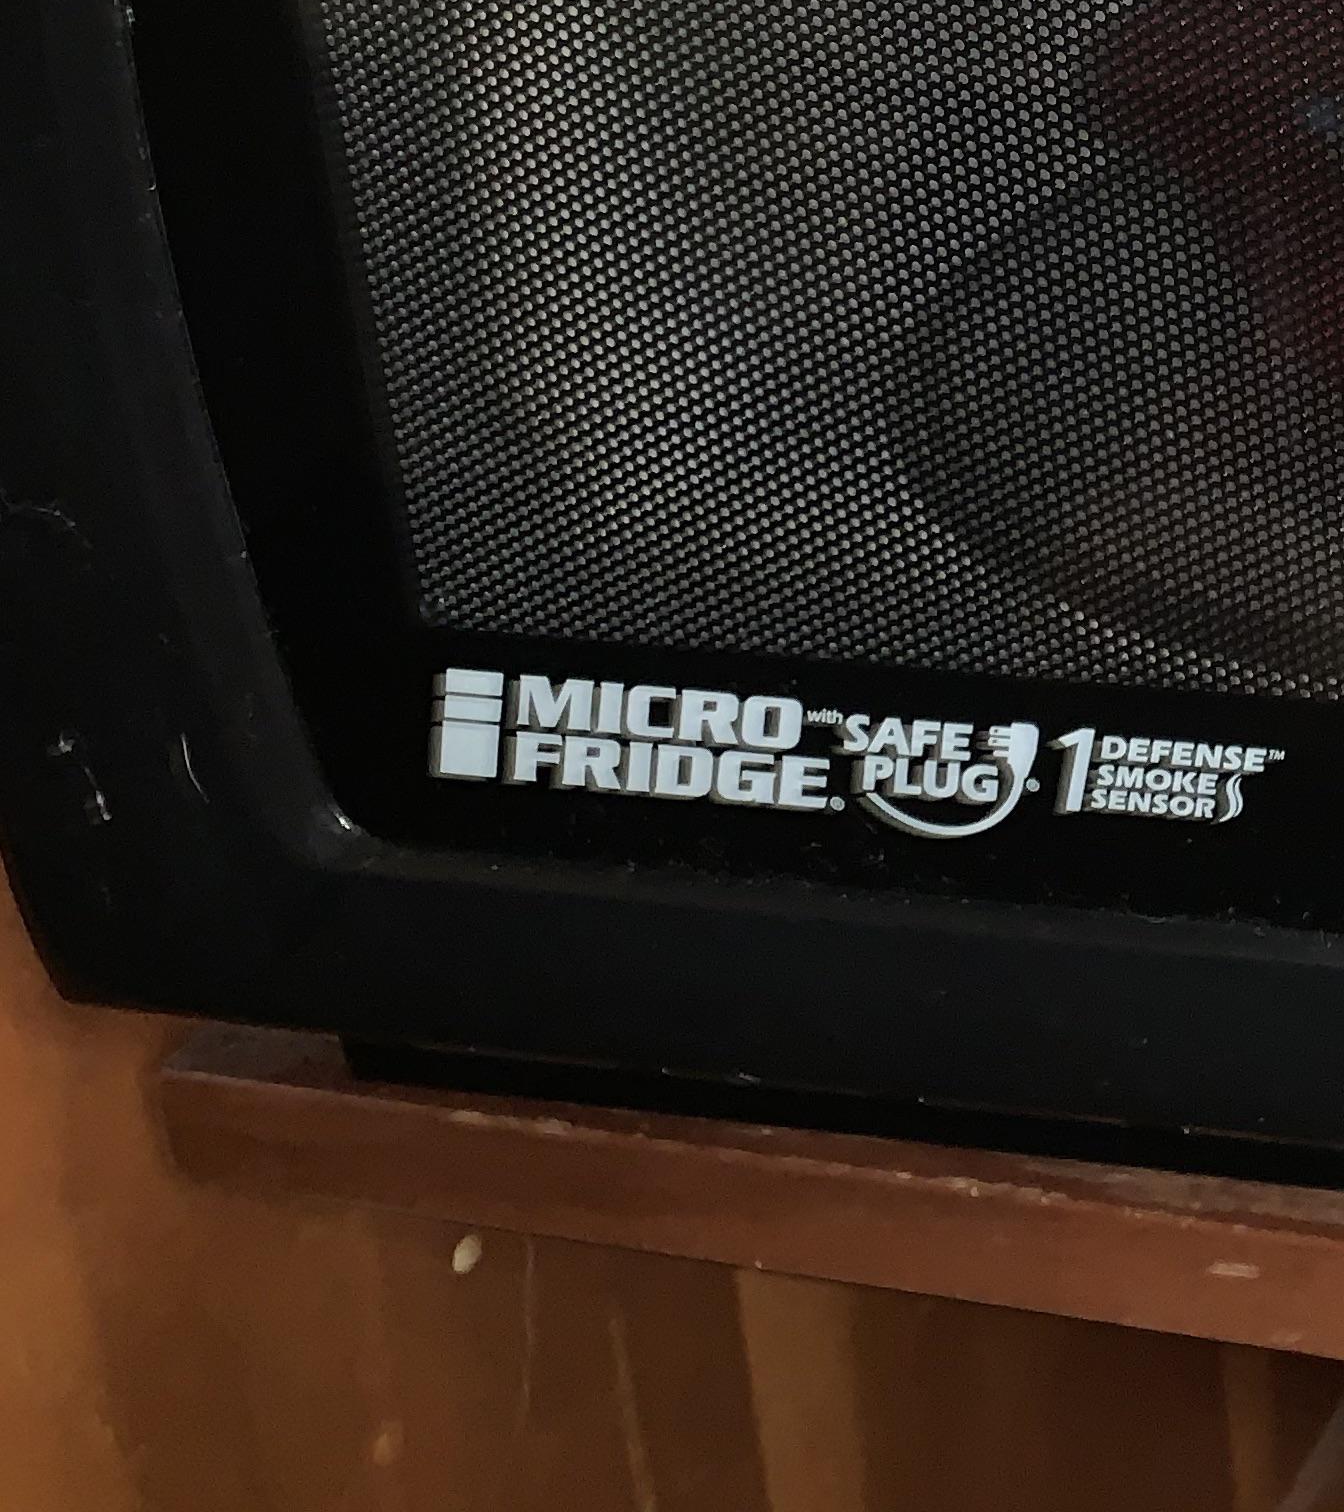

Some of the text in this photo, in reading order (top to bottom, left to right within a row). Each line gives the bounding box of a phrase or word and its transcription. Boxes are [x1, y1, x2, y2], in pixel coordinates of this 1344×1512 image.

[517, 674, 803, 750] MICRO
[807, 708, 844, 724] with
[843, 713, 974, 761] SAFE
[863, 754, 999, 802] PLUG
[1058, 728, 1096, 812] 1
[1097, 764, 1218, 796] SMOKE
[1091, 789, 1216, 818] SENSOR
